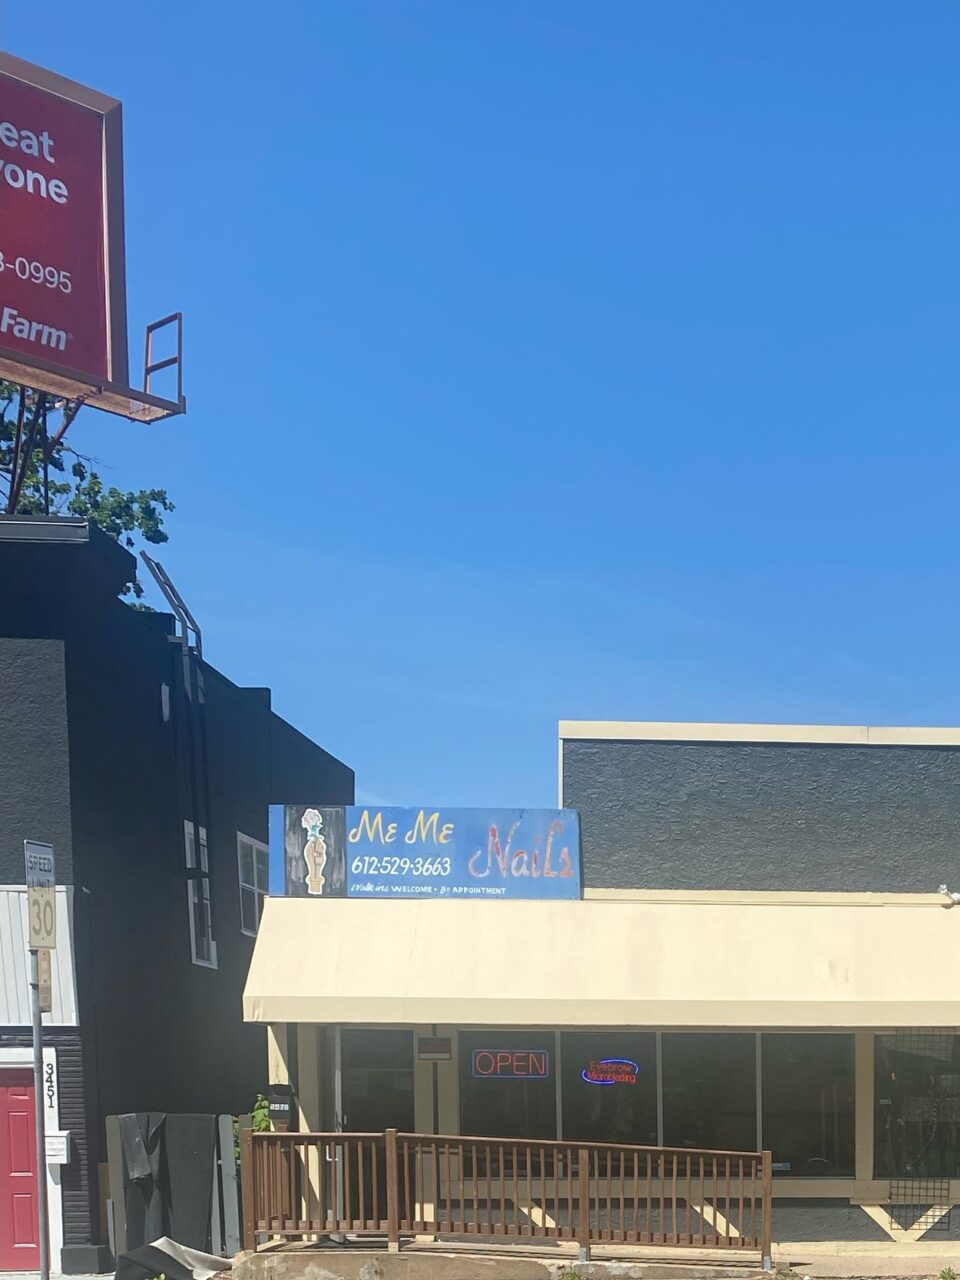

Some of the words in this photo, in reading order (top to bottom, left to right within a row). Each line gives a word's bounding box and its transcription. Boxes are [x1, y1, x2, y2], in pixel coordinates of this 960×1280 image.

[0, 158, 68, 204] one
[0, 306, 67, 351] Farm
[29, 855, 53, 873] SPEED
[31, 877, 51, 893] LIMIT
[391, 885, 433, 893] WELCOME
[452, 886, 506, 895] APPOINTMENT
[31, 898, 54, 937] 30
[476, 1052, 546, 1075] OPEN
[590, 1060, 632, 1072] Eyebrow
[45, 1063, 55, 1109] 3451
